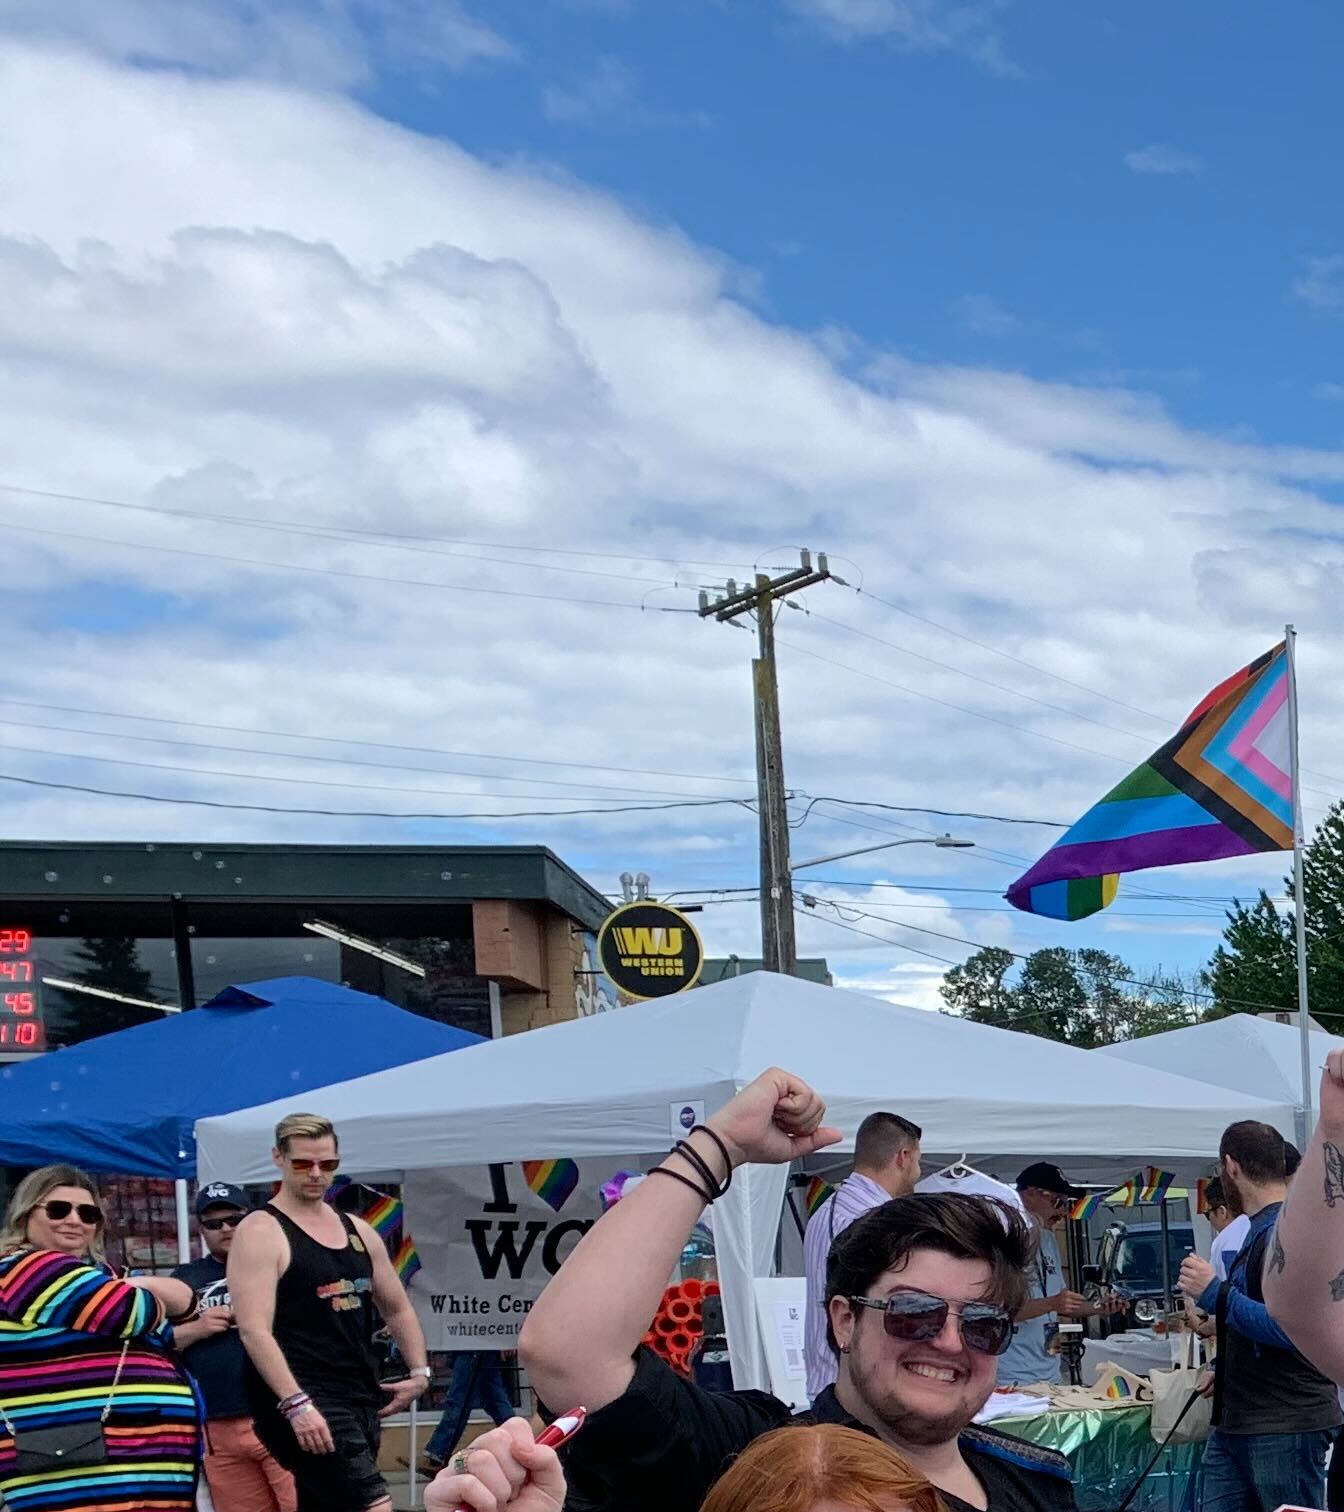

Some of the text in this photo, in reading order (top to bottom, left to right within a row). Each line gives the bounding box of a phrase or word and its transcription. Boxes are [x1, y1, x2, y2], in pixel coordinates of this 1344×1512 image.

[621, 958, 684, 967] WESTERN
[641, 967, 684, 976] UNION
[431, 1295, 534, 1314] White Cen
